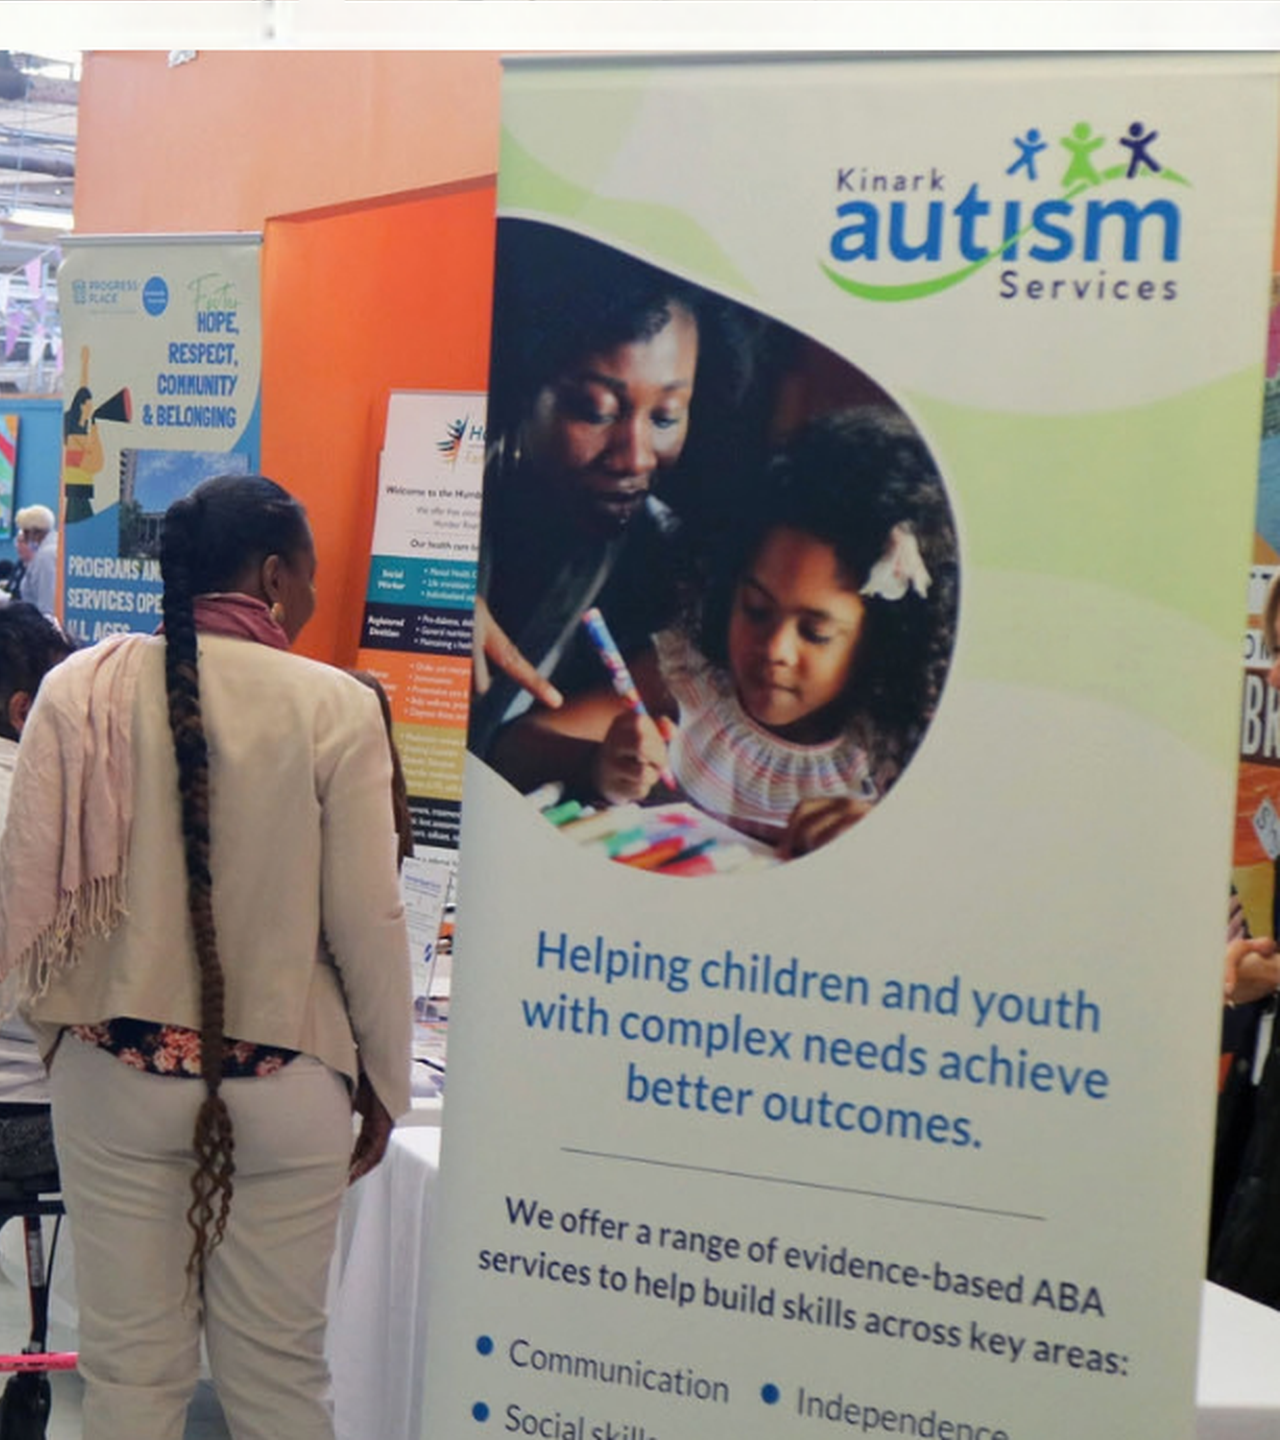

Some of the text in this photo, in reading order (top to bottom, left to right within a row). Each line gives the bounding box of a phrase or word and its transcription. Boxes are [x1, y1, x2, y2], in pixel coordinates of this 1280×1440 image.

[836, 167, 945, 193] Kinark
[829, 183, 1181, 263] autism
[88, 292, 119, 304] PLACE
[999, 270, 1178, 300] Services
[196, 311, 240, 335] HOPE,
[168, 341, 239, 367] RESPECT,
[157, 373, 238, 396] COMMUNITY
[142, 404, 237, 429] & BELONGING
[68, 555, 164, 582] PROGRAMS AN
[67, 587, 165, 616] SERVICES OPE
[67, 618, 91, 642] ALL
[536, 929, 1101, 1032] Helping children and youth
[521, 993, 1110, 1099] with complex needs achieve
[626, 1062, 983, 1149] better outcomes.
[504, 1195, 1106, 1318] We offer a range of evidence-based ABA
[478, 1246, 1130, 1377] services to help build skills across key areas:
[508, 1338, 730, 1405] Communication
[504, 1403, 584, 1440] Social
[796, 1386, 1011, 1440] Independence
